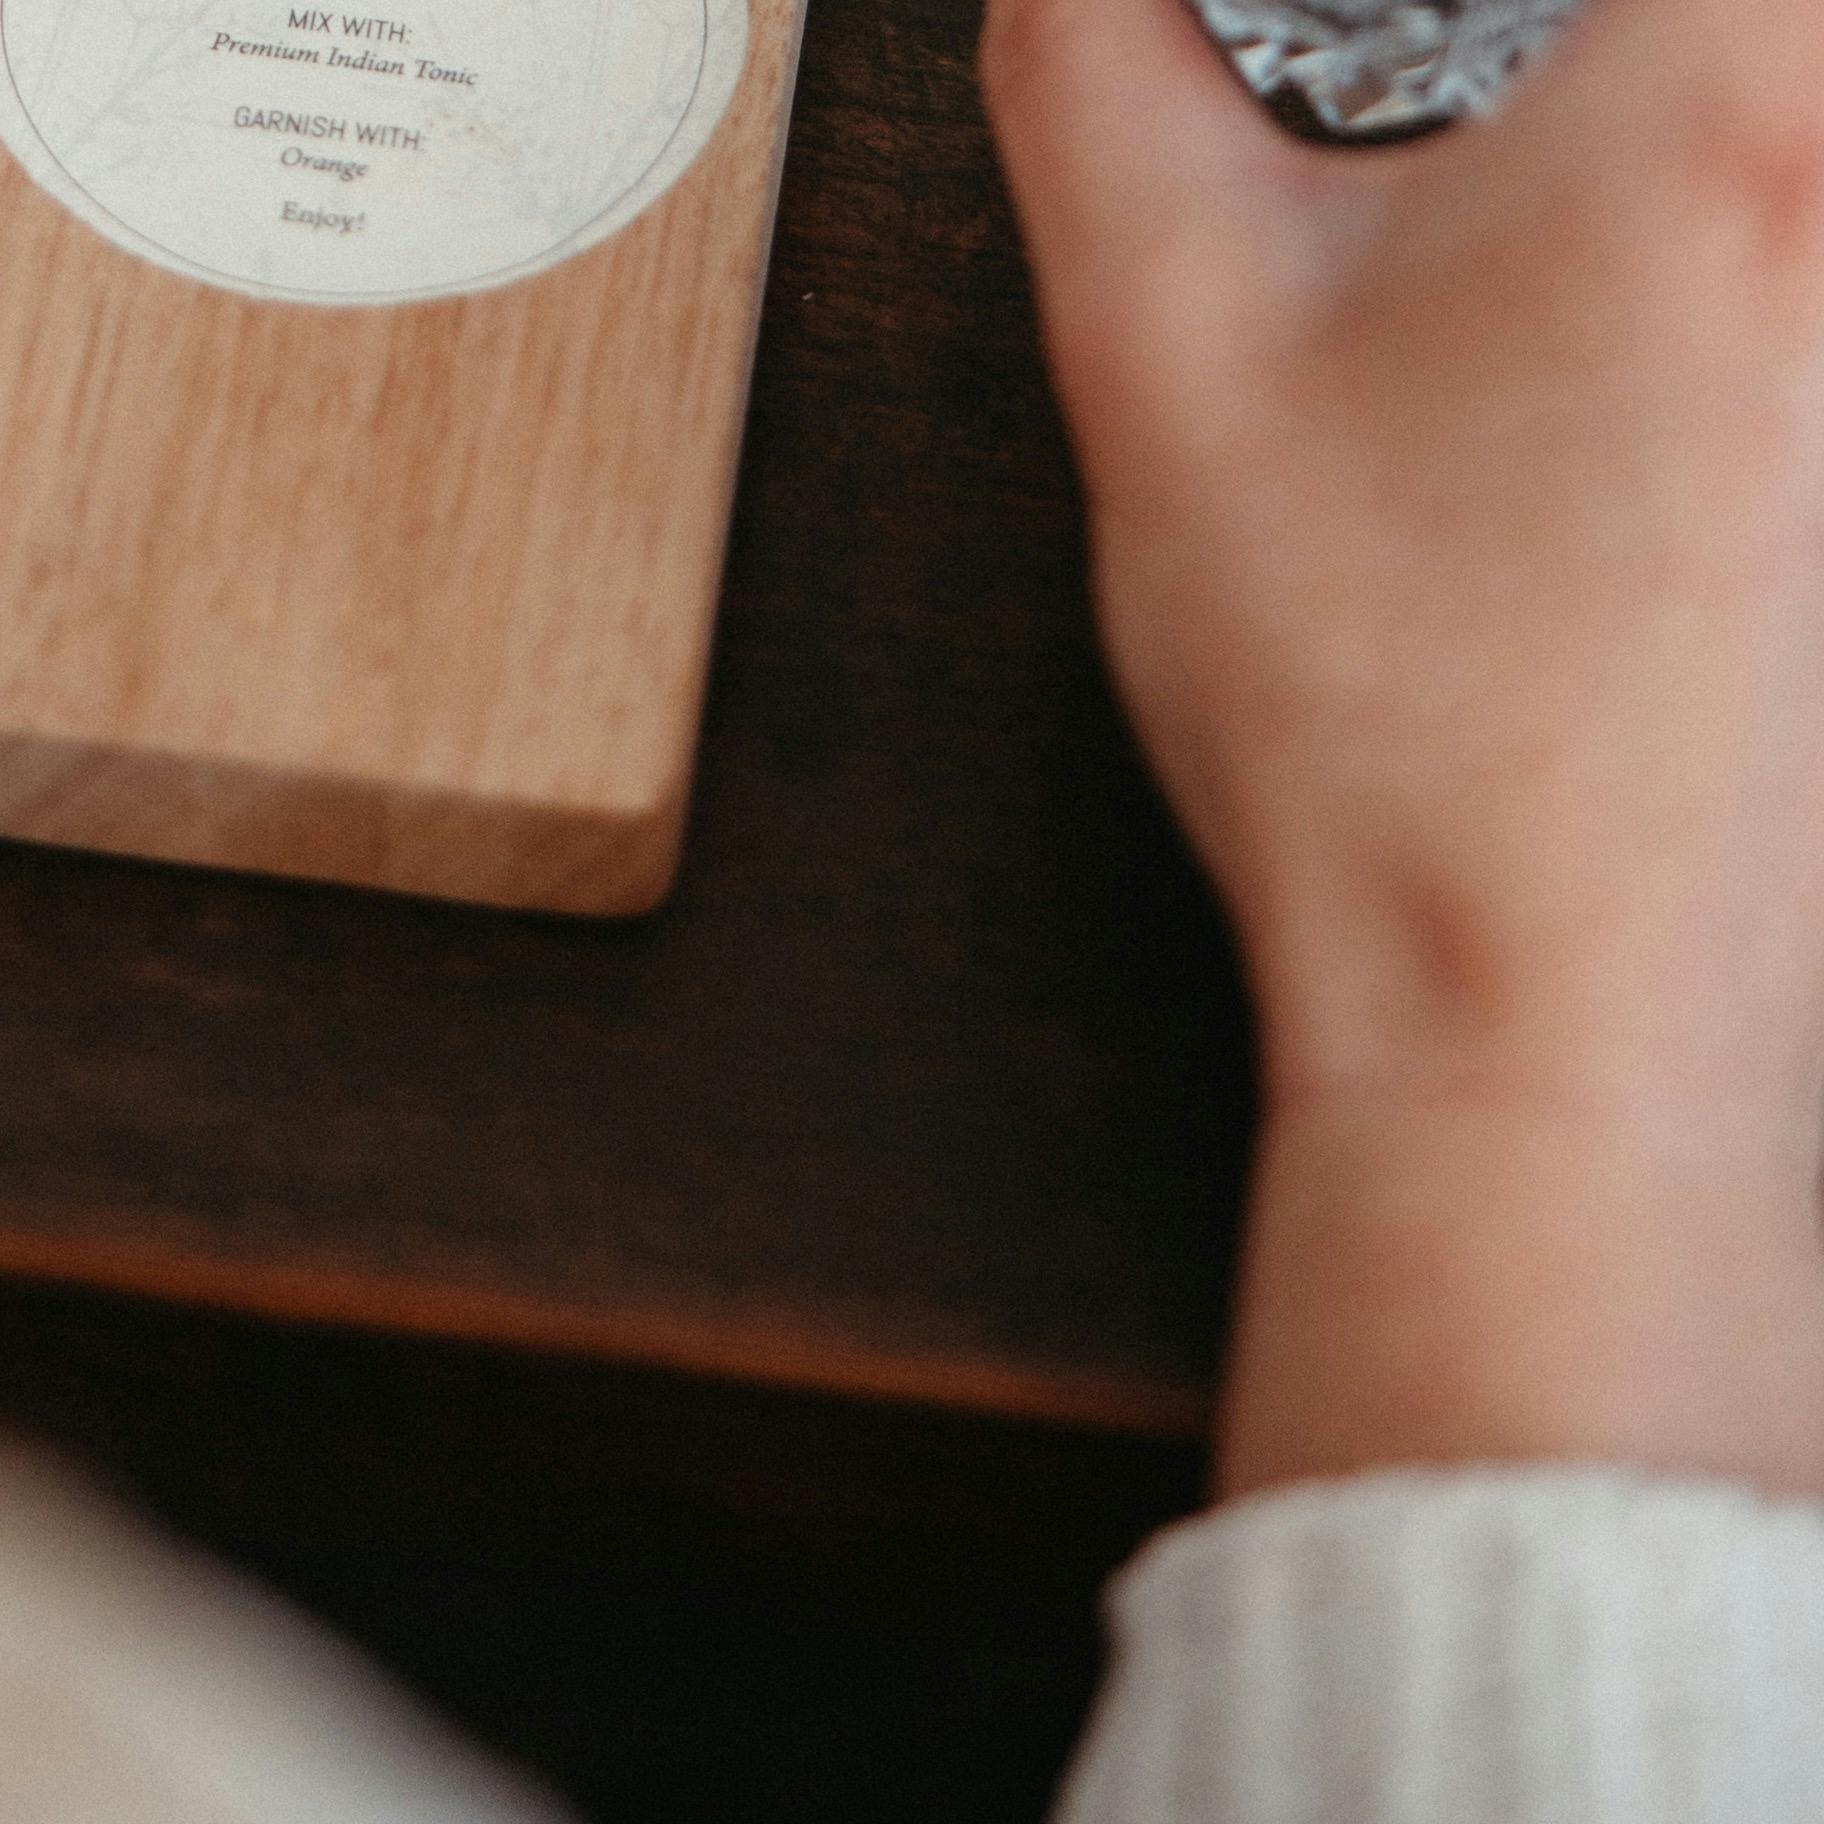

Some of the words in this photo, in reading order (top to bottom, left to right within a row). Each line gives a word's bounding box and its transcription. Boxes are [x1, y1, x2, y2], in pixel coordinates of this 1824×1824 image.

[287, 8, 333, 34] MIX
[342, 14, 414, 45] WITH:
[210, 31, 320, 65] Premium
[327, 46, 405, 76] Indian
[415, 58, 479, 87] Tonic
[233, 105, 346, 141] GARNISH
[279, 146, 370, 182] Orange
[280, 200, 367, 233] Enjoy!
